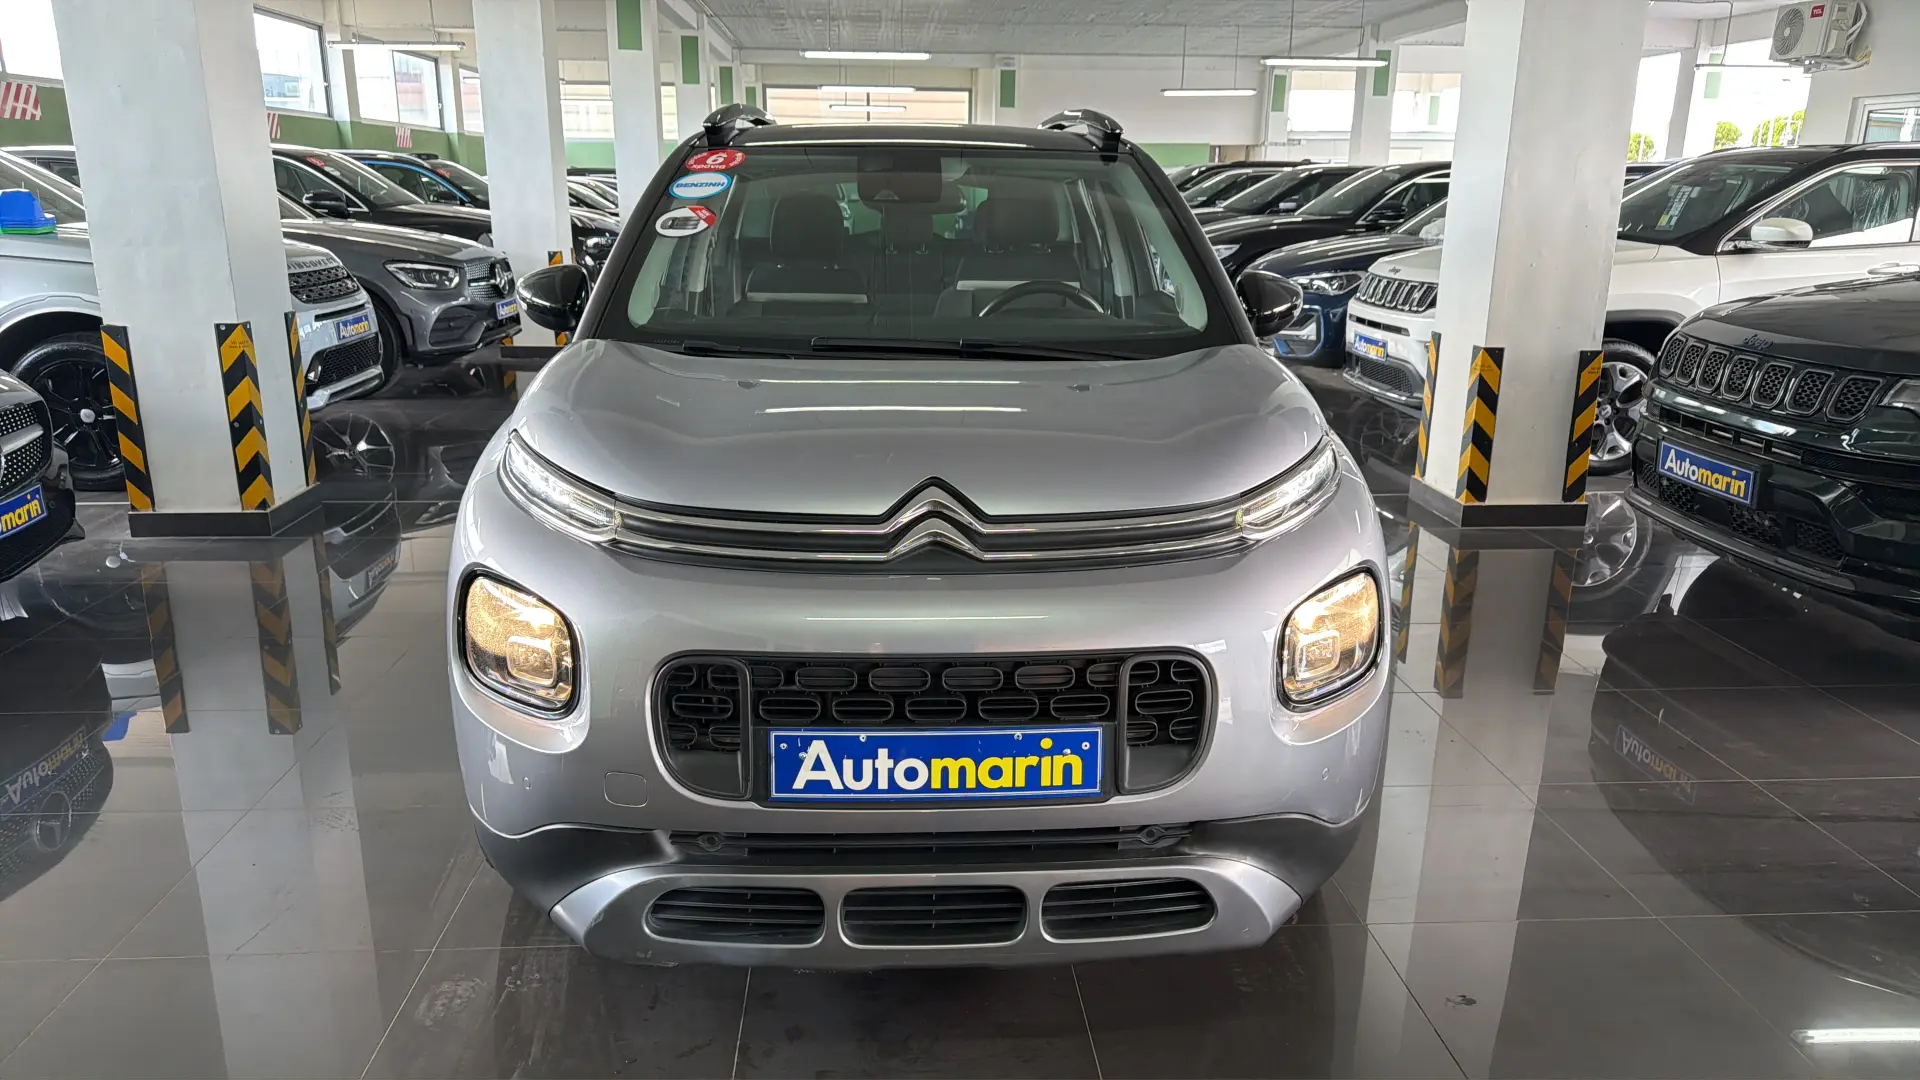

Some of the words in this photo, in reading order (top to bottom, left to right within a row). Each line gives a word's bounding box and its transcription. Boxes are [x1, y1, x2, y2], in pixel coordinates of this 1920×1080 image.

[706, 154, 727, 165] 6
[340, 315, 369, 339] Automarin
[1354, 335, 1385, 358] Automarin
[1664, 448, 1746, 498] Automarin
[0, 493, 42, 533] marin
[791, 737, 1083, 791] Automarin
